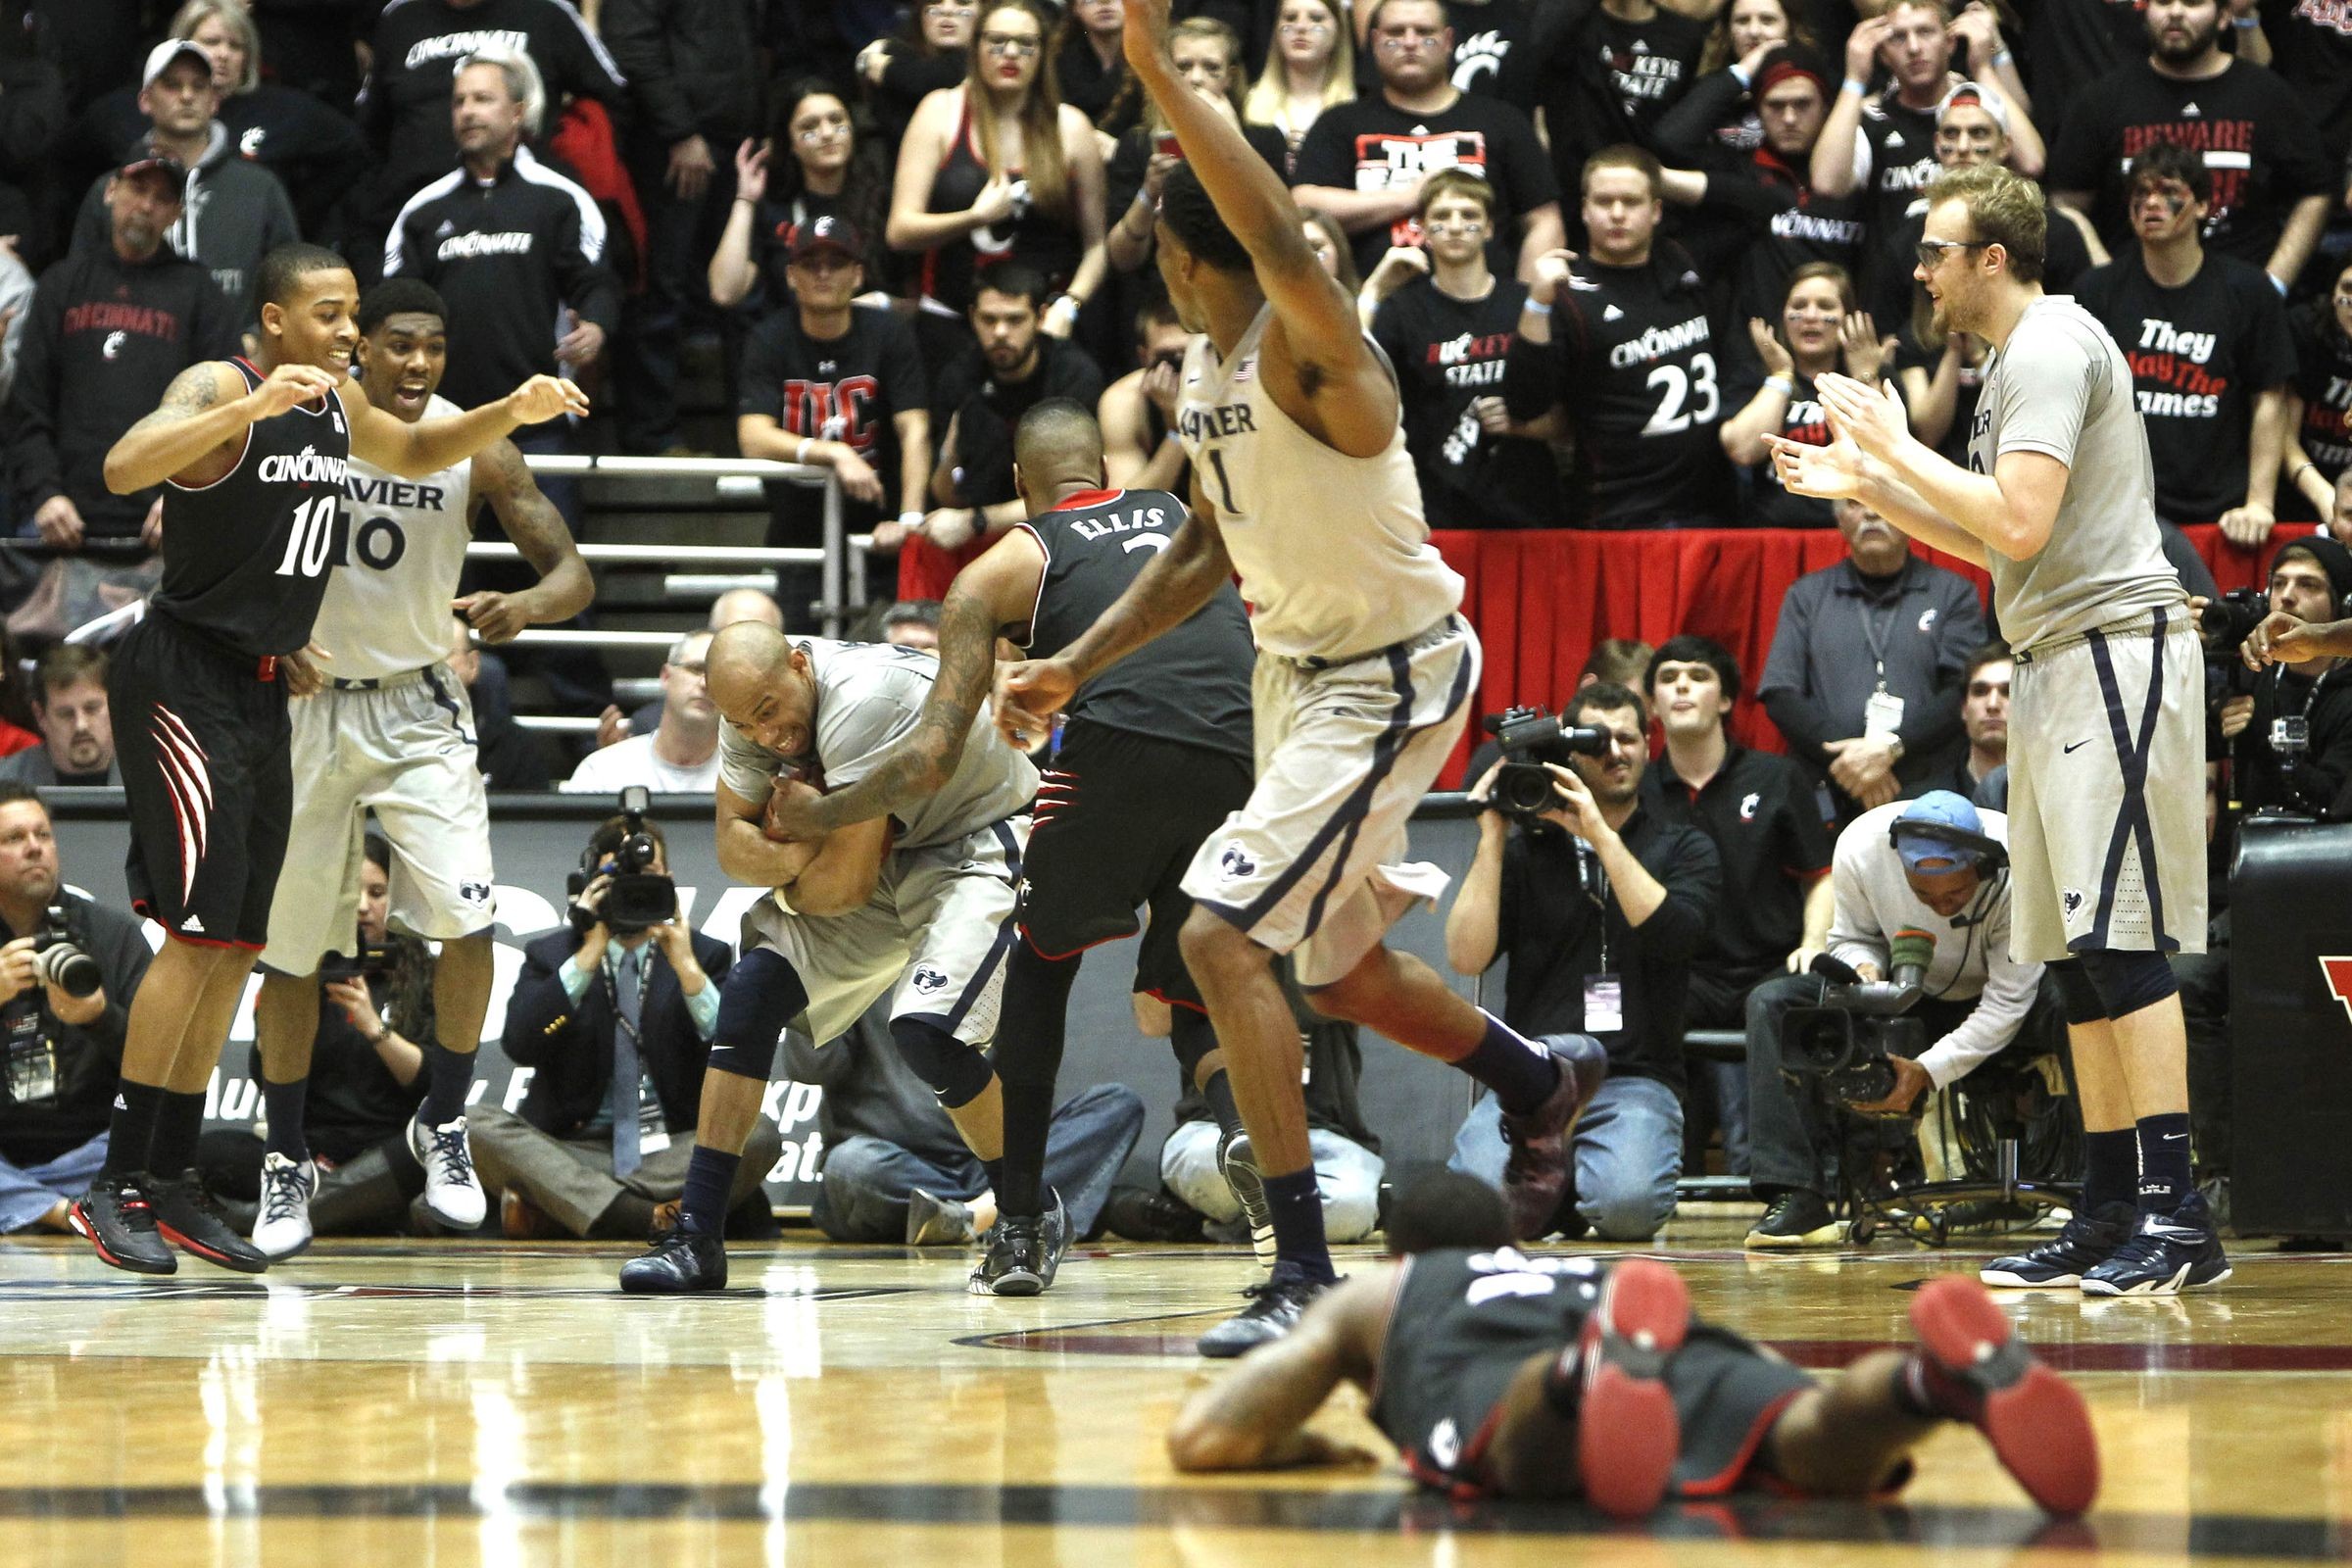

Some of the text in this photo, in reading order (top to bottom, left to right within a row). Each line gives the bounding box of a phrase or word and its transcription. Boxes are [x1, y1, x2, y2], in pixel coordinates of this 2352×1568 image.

[2138, 318, 2217, 364] They
[1641, 352, 1720, 437] 23
[1207, 449, 1245, 514] 1
[275, 495, 336, 577] 10
[1070, 508, 1164, 541] ELLIS
